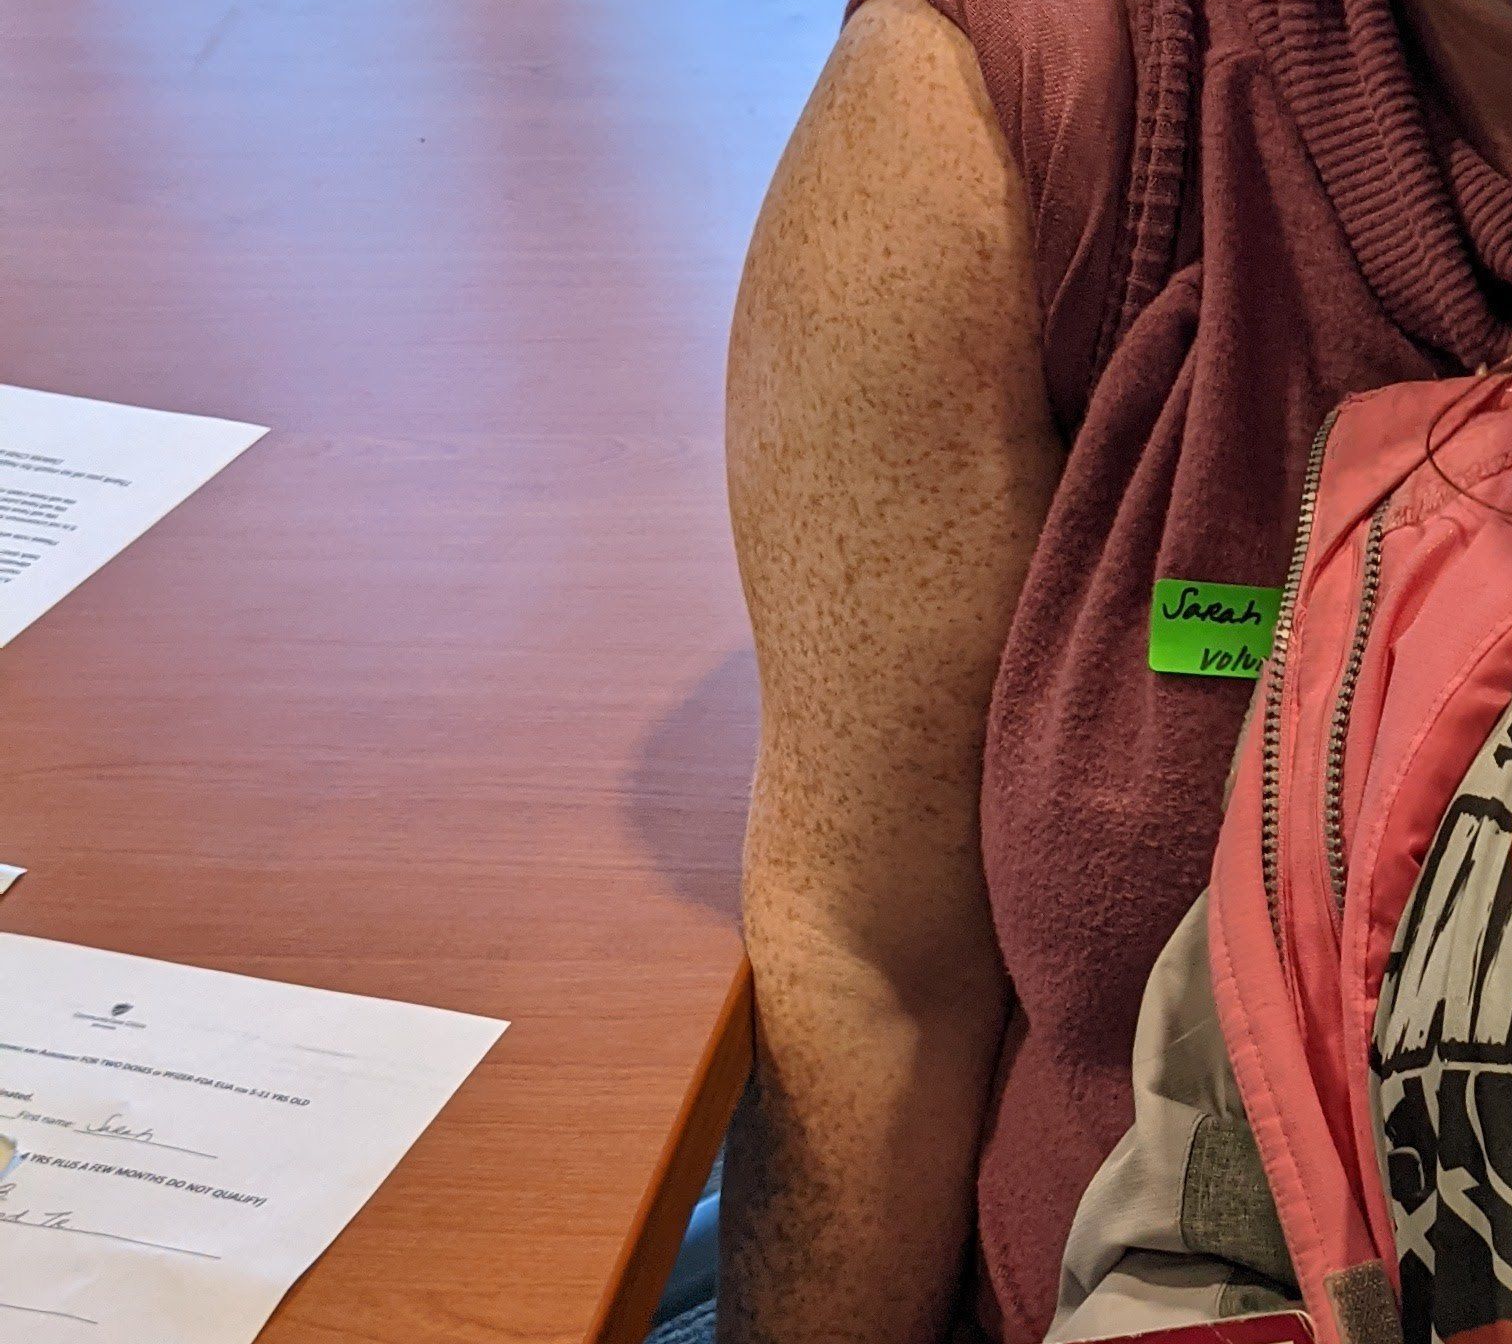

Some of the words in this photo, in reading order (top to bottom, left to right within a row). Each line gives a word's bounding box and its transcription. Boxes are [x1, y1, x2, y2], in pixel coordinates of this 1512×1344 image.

[289, 1096, 311, 1106] OLD
[30, 1154, 52, 1165] YRS
[51, 1158, 81, 1170] PLUS
[78, 1162, 89, 1171] A
[88, 1163, 117, 1174] FEW
[115, 1167, 168, 1185] MONTHS
[165, 1178, 187, 1188] DO
[185, 1182, 214, 1194] NOT
